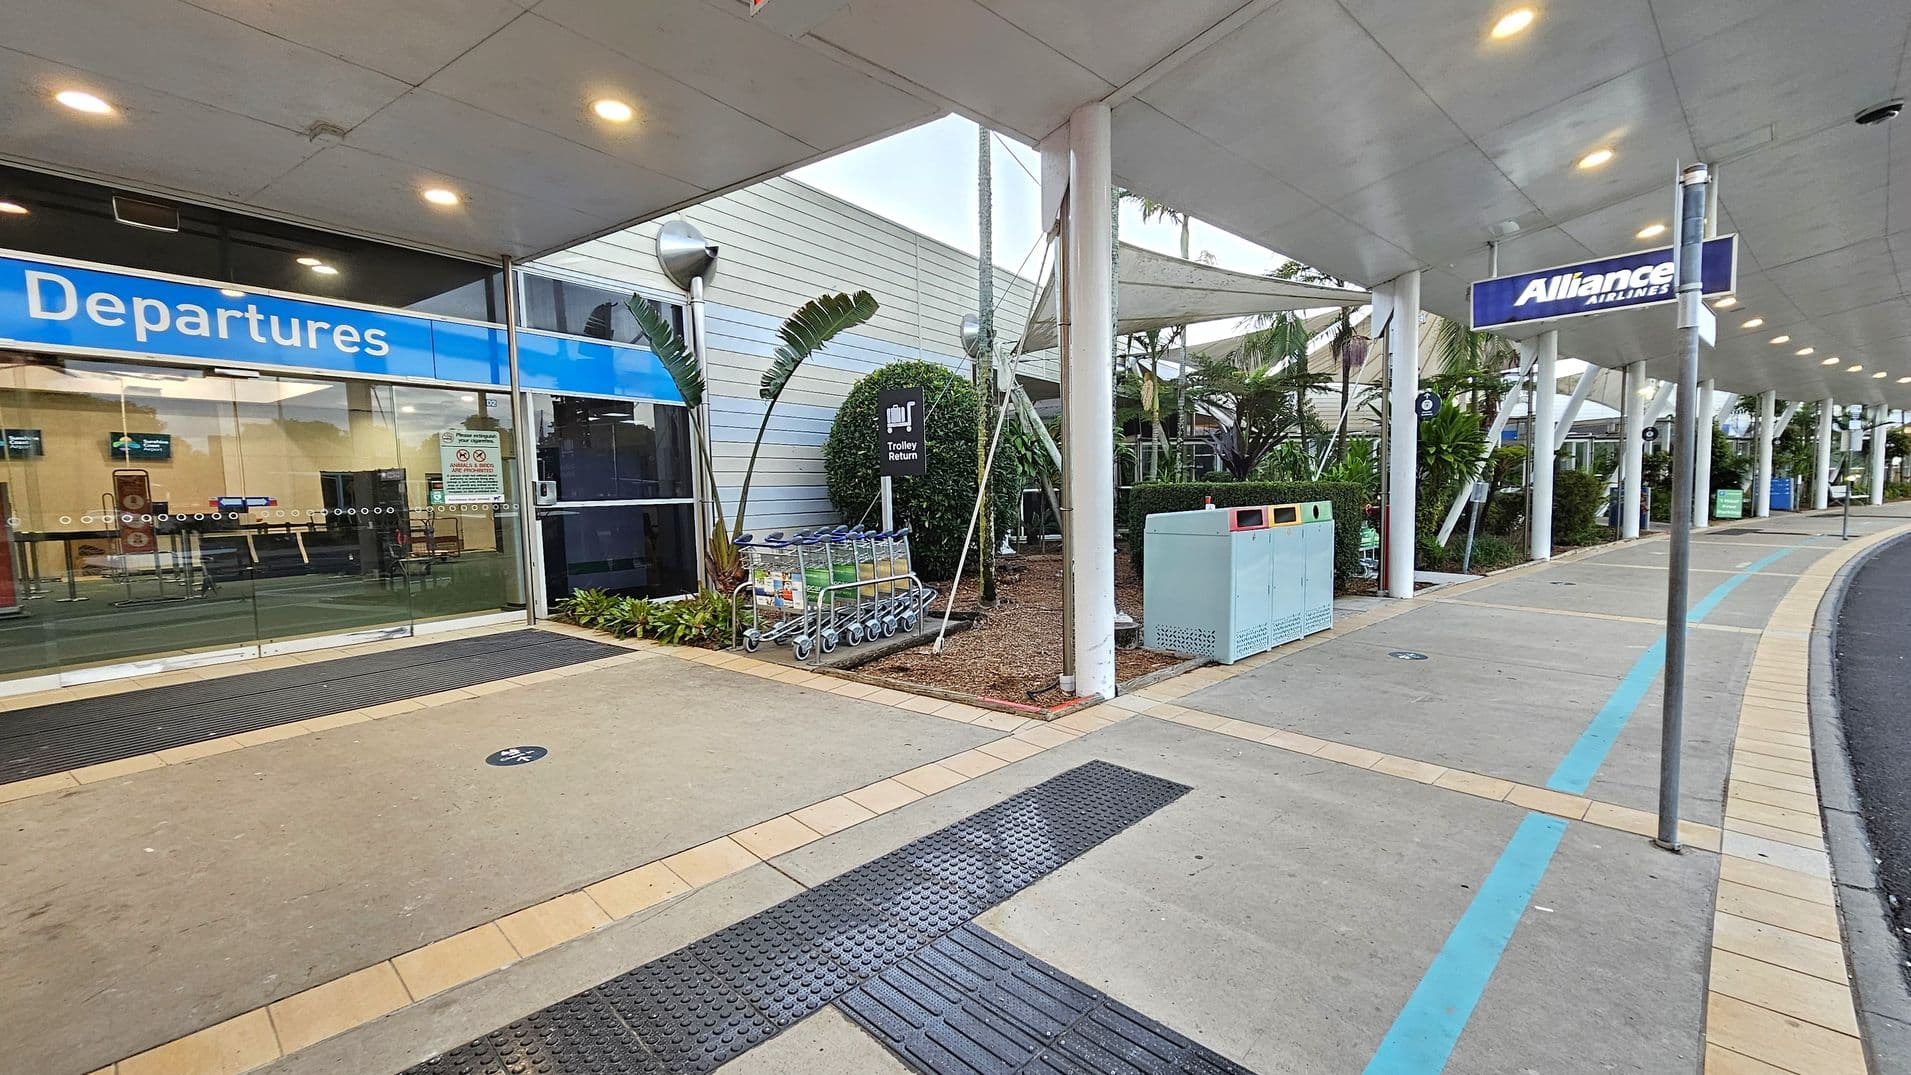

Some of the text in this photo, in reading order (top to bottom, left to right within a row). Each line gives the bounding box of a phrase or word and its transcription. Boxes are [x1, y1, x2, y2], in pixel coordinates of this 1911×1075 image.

[1513, 262, 1675, 307] Alliance
[1584, 284, 1670, 305] AIRLINES
[24, 269, 390, 357] Departures
[887, 441, 917, 451] Trolley
[889, 452, 918, 460] Return
